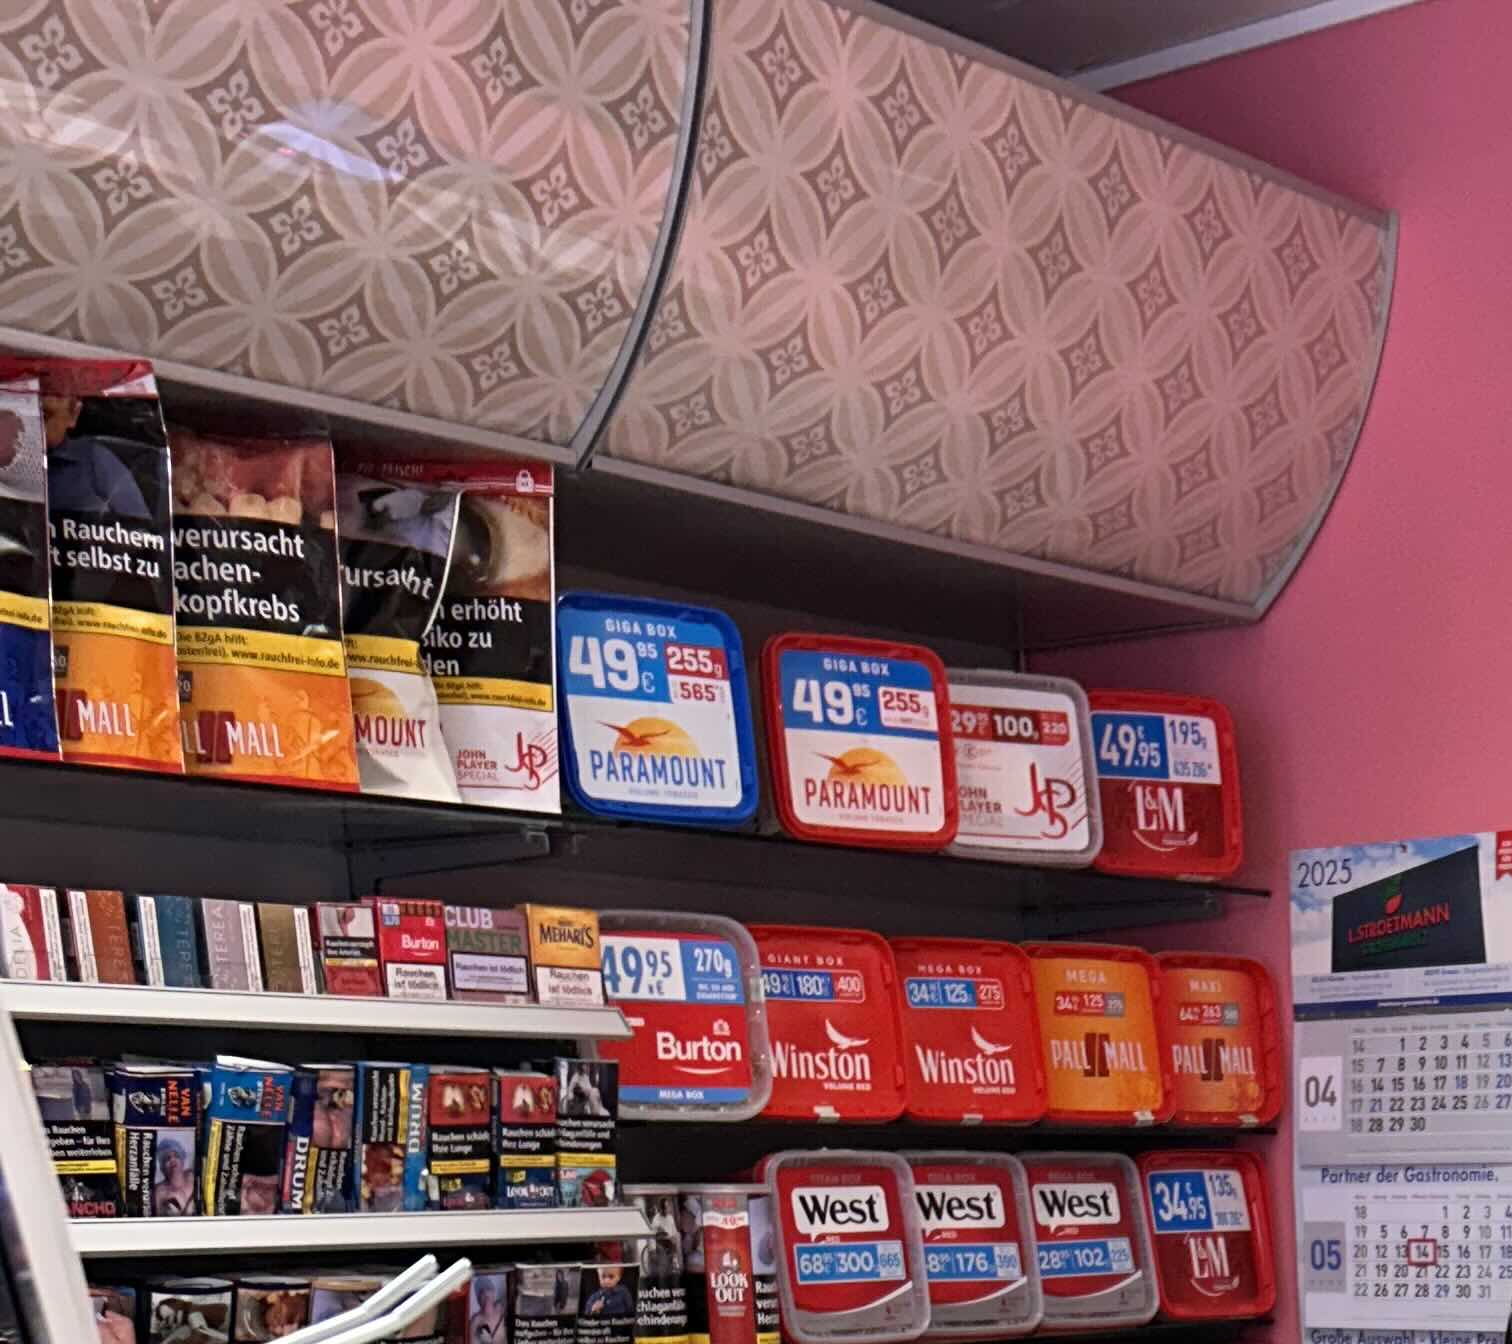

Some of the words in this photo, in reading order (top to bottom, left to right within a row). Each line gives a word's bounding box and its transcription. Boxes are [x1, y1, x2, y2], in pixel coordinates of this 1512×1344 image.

[61, 546, 133, 573] selbst
[136, 558, 160, 578] zu
[451, 599, 522, 623] erhöht
[605, 619, 641, 635] GIGA
[645, 623, 677, 639] BOX
[77, 699, 135, 738] MALL
[226, 720, 284, 758] MALL
[589, 750, 726, 789] PARAMOUNT
[804, 778, 931, 815] PARAMOUNT
[1134, 784, 1185, 832] L&M
[1298, 858, 1352, 888] 2025
[445, 906, 493, 929] CLUB
[401, 934, 439, 951] Burton
[448, 930, 522, 953] MASTER
[767, 953, 809, 966] GIANT
[816, 956, 844, 966] BOX
[1066, 970, 1106, 983] MEGA
[656, 1031, 742, 1062] Burton
[770, 1041, 870, 1081] Winston
[1050, 1039, 1089, 1070] PALL
[1104, 1042, 1147, 1071] MALL
[1172, 1045, 1208, 1074] PALL
[1220, 1046, 1255, 1075] MALL
[915, 1045, 1015, 1085] Winston
[1304, 1075, 1337, 1108] 04
[408, 1082, 424, 1154] DRUM
[1321, 1168, 1370, 1184] Partner
[1377, 1168, 1399, 1183] der
[1405, 1167, 1499, 1184] Gastronomie.
[799, 1194, 879, 1227] West
[915, 1191, 997, 1224] West
[1039, 1190, 1111, 1219] West
[1310, 1239, 1342, 1271] 05
[711, 1272, 748, 1289] LOOK
[715, 1286, 745, 1303] OUT
